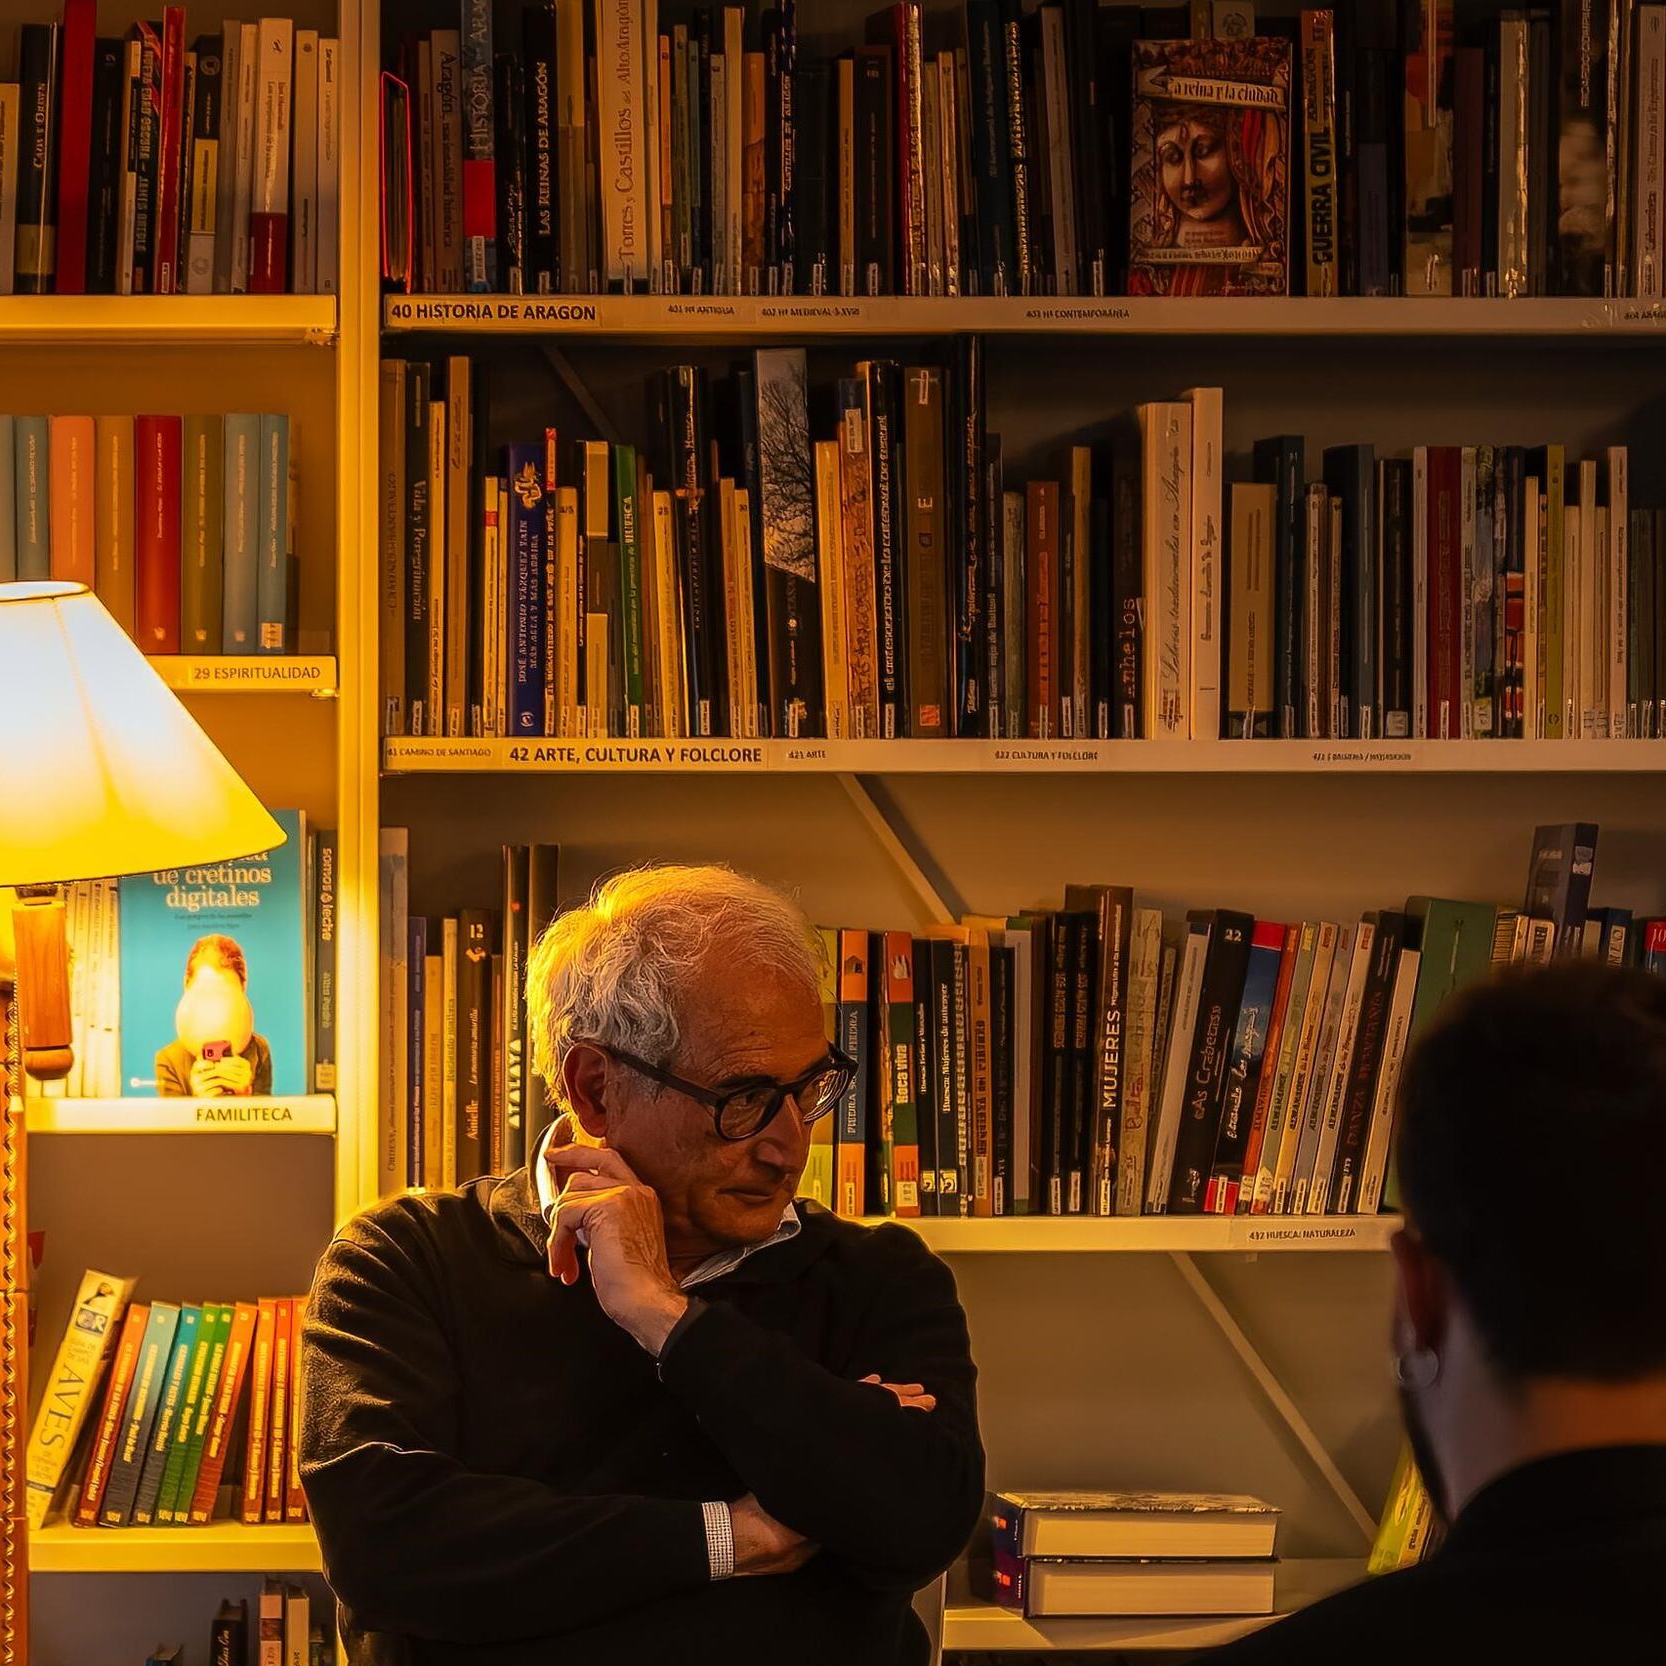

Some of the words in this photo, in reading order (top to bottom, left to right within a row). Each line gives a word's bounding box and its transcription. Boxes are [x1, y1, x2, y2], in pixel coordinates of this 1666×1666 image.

[535, 62, 549, 124] ARAGÓN
[537, 129, 549, 148] DE
[614, 107, 634, 194] Castillos
[1309, 127, 1331, 177] CIVIL
[537, 153, 550, 205] REINAS
[538, 210, 551, 235] LAS
[1311, 184, 1334, 266] GUERRA
[391, 304, 411, 318] 40
[416, 304, 493, 319] HISTORIA
[497, 304, 519, 319] DE
[523, 305, 596, 320] ARAGON
[194, 667, 210, 679] 29
[214, 666, 321, 679] ESPIRITUALIDAD
[510, 748, 529, 762] 42
[534, 748, 580, 764] ARTE,
[585, 748, 660, 762] CULTURA
[664, 748, 676, 762] Y
[681, 748, 762, 762] FOLCLORE
[185, 862, 272, 885] cretinos
[322, 847, 334, 891] somos
[166, 886, 261, 911] digitales
[321, 904, 334, 942] leche
[1102, 1009, 1121, 1108] MUJERES
[508, 1039, 522, 1130] ATALAYA
[196, 1107, 292, 1121] FAMILITECA
[39, 1363, 85, 1449] AVES
